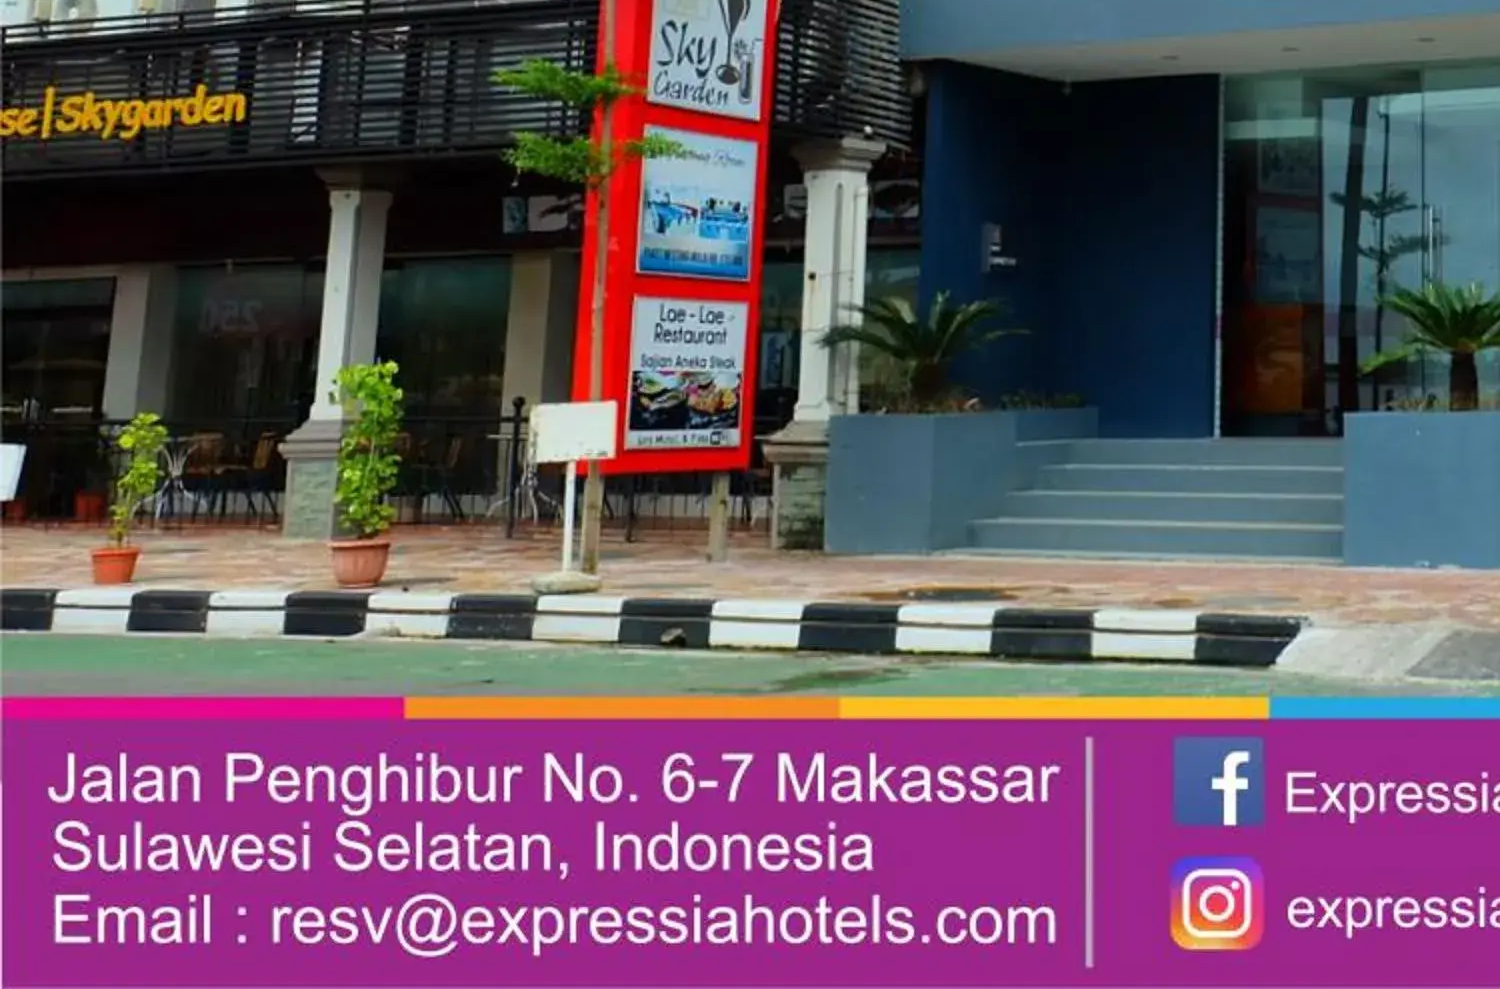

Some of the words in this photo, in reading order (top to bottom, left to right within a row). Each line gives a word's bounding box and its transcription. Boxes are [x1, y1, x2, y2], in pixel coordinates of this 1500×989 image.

[656, 19, 718, 78] Sky
[653, 70, 729, 107] Garden
[654, 322, 728, 346] Restaurant
